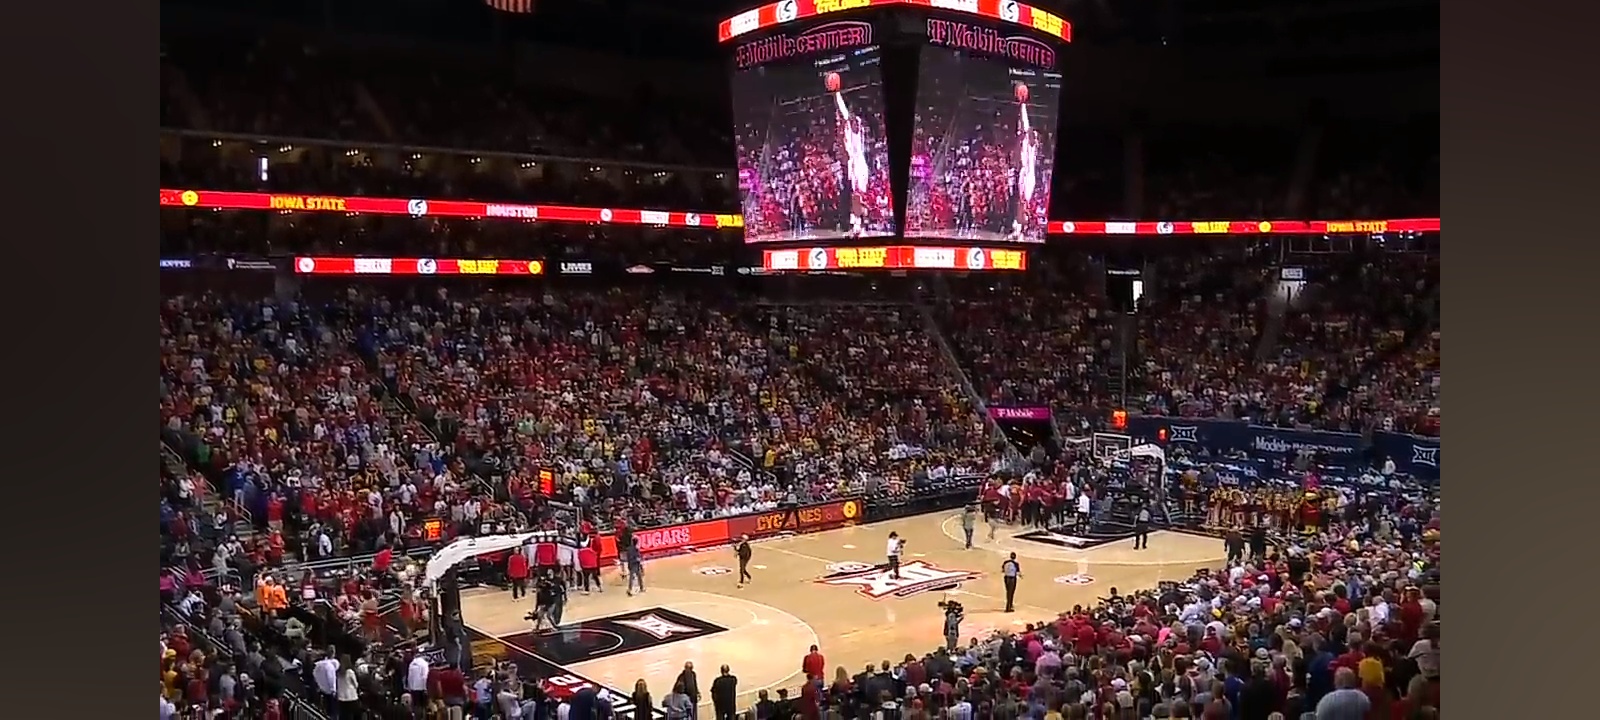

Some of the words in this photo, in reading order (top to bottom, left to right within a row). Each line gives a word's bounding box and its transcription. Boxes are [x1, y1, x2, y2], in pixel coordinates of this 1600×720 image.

[796, 26, 866, 54] CENTER
[270, 195, 305, 209] IOWA
[306, 197, 346, 211] STATE
